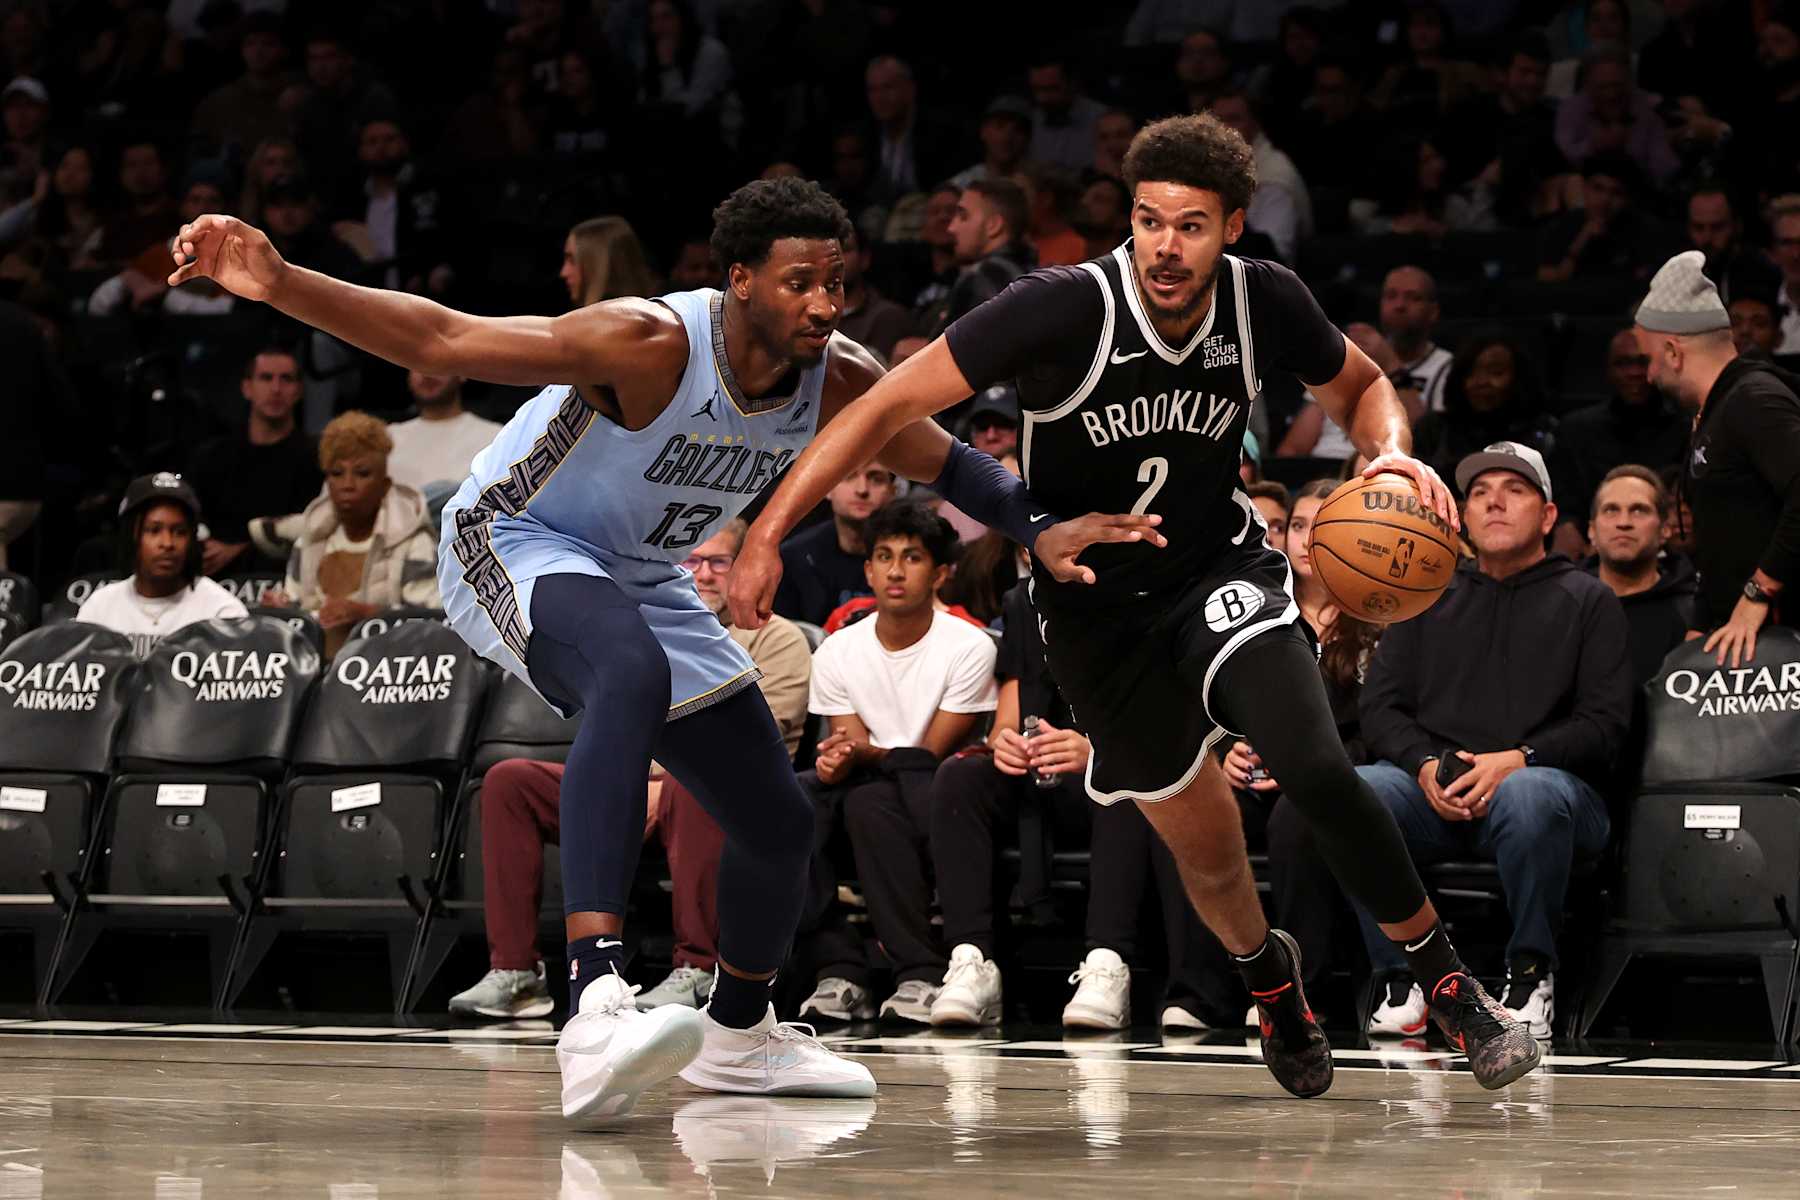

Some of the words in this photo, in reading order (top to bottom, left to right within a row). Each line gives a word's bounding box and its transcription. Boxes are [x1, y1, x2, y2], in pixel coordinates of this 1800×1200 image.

[1203, 335, 1224, 348] GET
[1204, 343, 1236, 358] YOUR
[1203, 354, 1239, 369] GUIDE
[1081, 389, 1240, 447] BROOKLYN
[644, 434, 794, 494] GRIZZLIES
[1130, 456, 1168, 516] 2
[643, 502, 722, 549] 13
[1220, 589, 1246, 623] B
[0, 660, 106, 694] QATAR
[171, 650, 289, 688] QATAR
[337, 654, 456, 691] QATAR
[1665, 662, 1800, 704] QATAR
[13, 689, 98, 711] AIRWAYS
[195, 679, 284, 702] AIRWAYS
[361, 682, 451, 704] AIRWAYS
[1698, 691, 1800, 717] AIRWAYS
